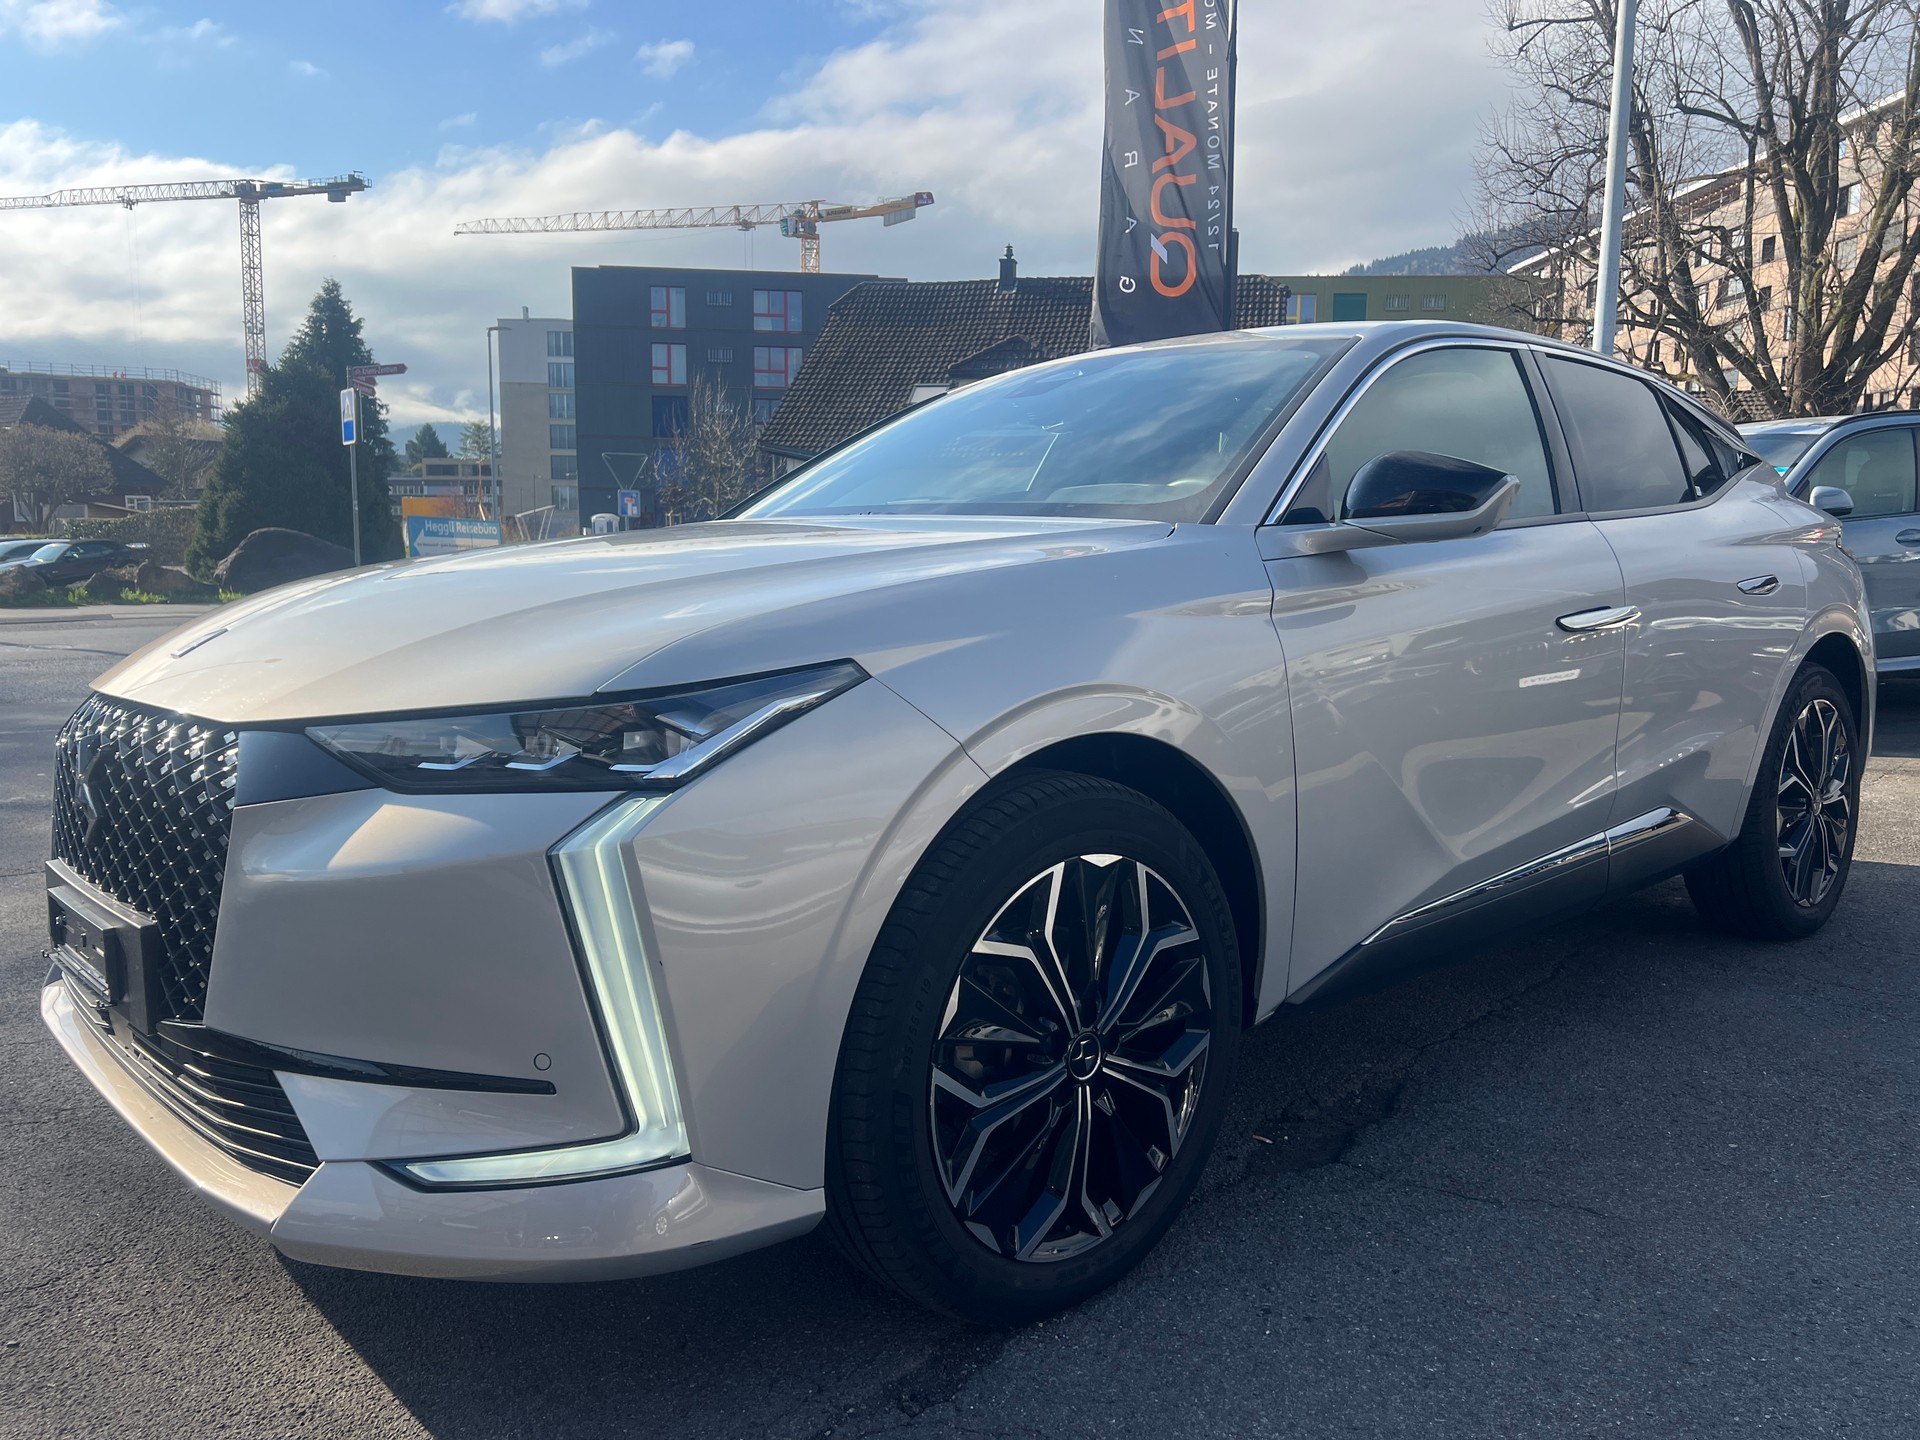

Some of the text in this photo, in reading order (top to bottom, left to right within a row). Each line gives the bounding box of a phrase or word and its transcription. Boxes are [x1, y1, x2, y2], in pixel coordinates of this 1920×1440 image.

[456, 520, 498, 535] Reisebüro
[901, 977, 932, 1075] 205/55 R 19
